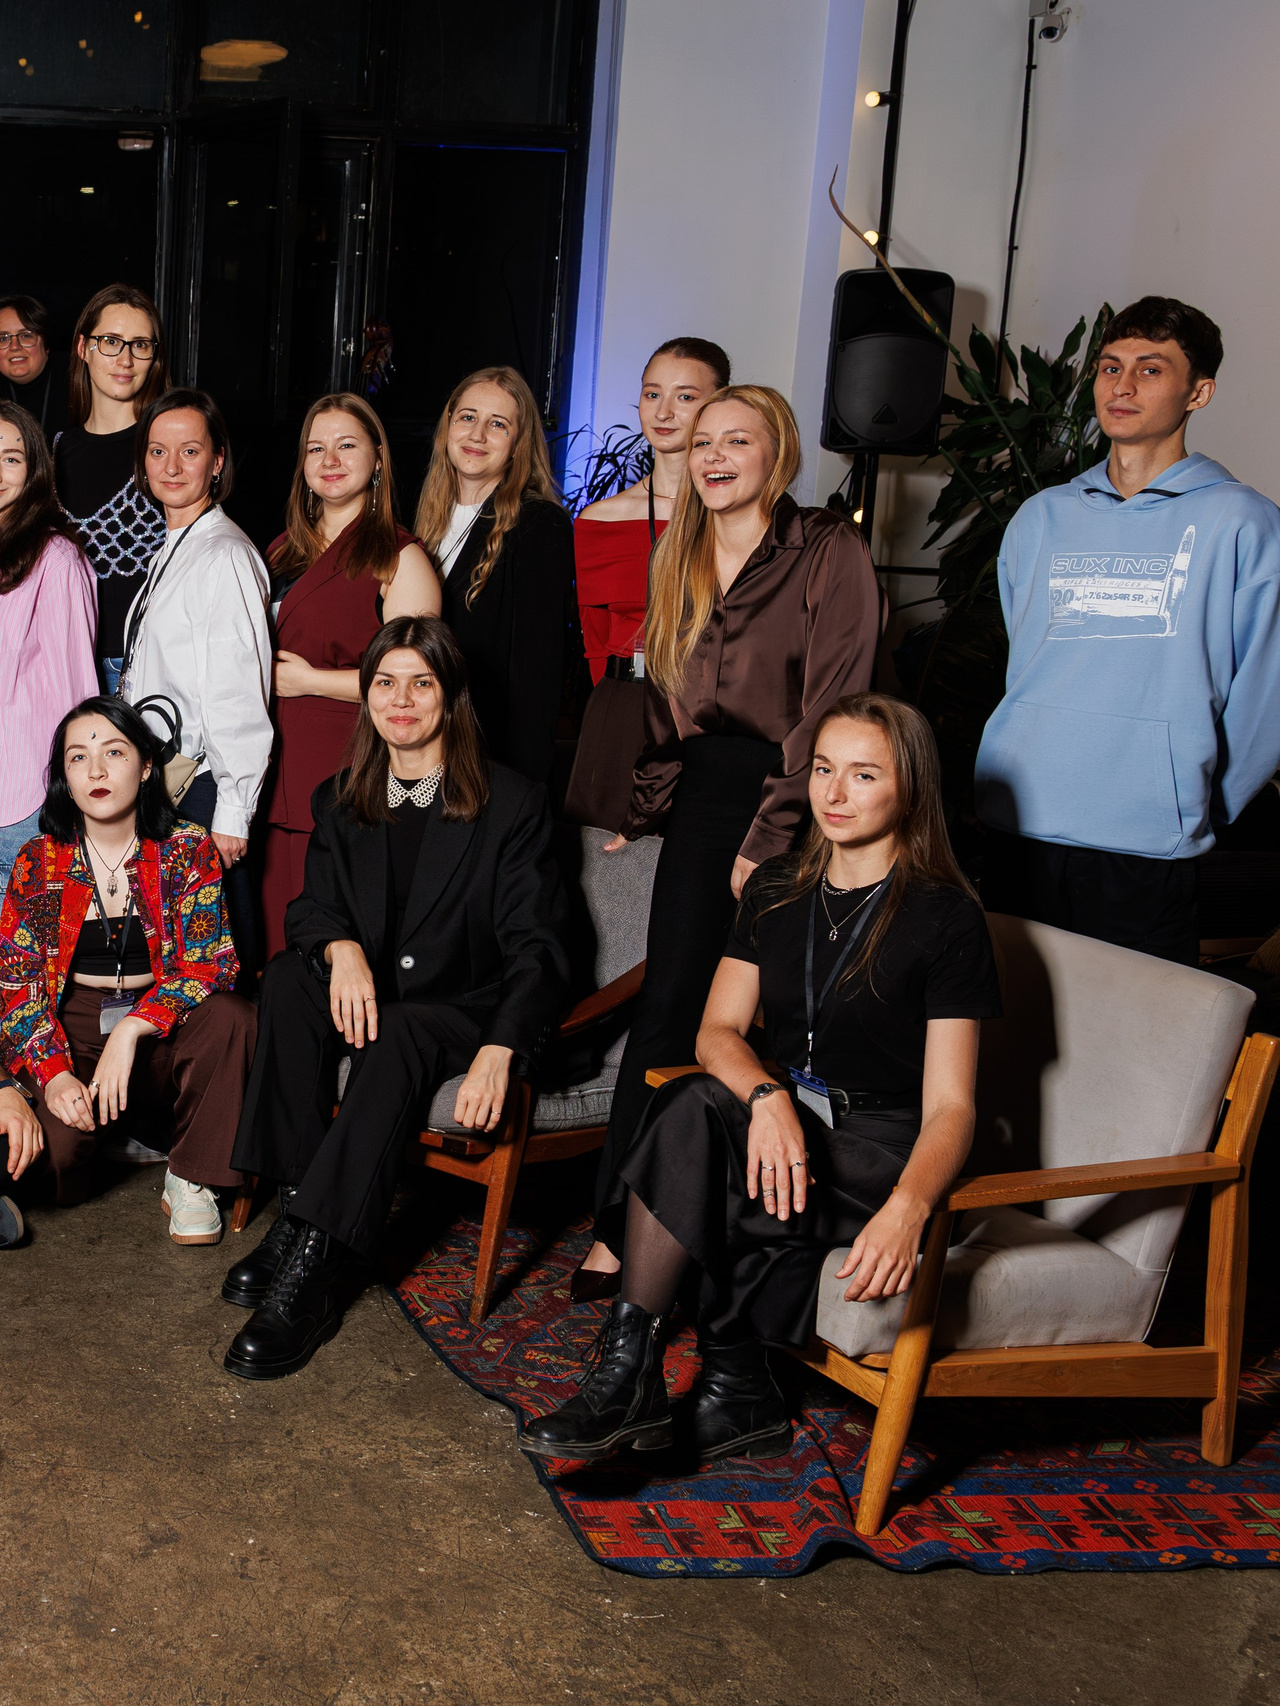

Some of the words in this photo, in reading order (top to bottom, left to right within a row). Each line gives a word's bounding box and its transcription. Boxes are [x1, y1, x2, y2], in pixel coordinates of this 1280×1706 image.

[1051, 557, 1111, 574] SUX
[1112, 557, 1168, 575] INC
[1053, 588, 1074, 606] 20
